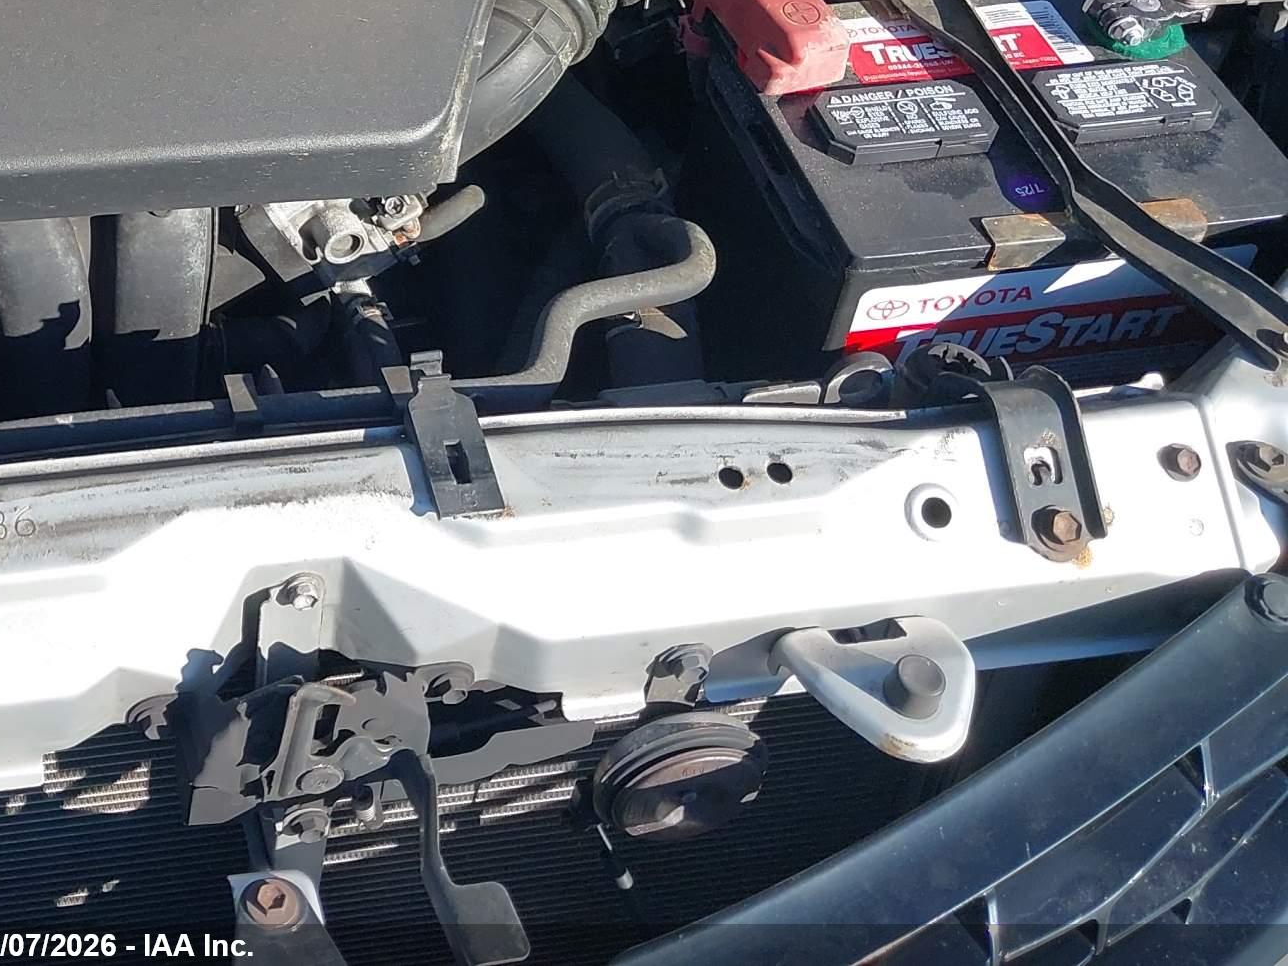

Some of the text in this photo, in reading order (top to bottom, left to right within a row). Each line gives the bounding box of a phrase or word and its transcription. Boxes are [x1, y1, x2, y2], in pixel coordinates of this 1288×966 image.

[861, 24, 916, 34] TOYOTA
[841, 85, 954, 104] DANGER / POISON
[1015, 183, 1044, 197] 7/25
[918, 286, 1032, 313] TOYOTA
